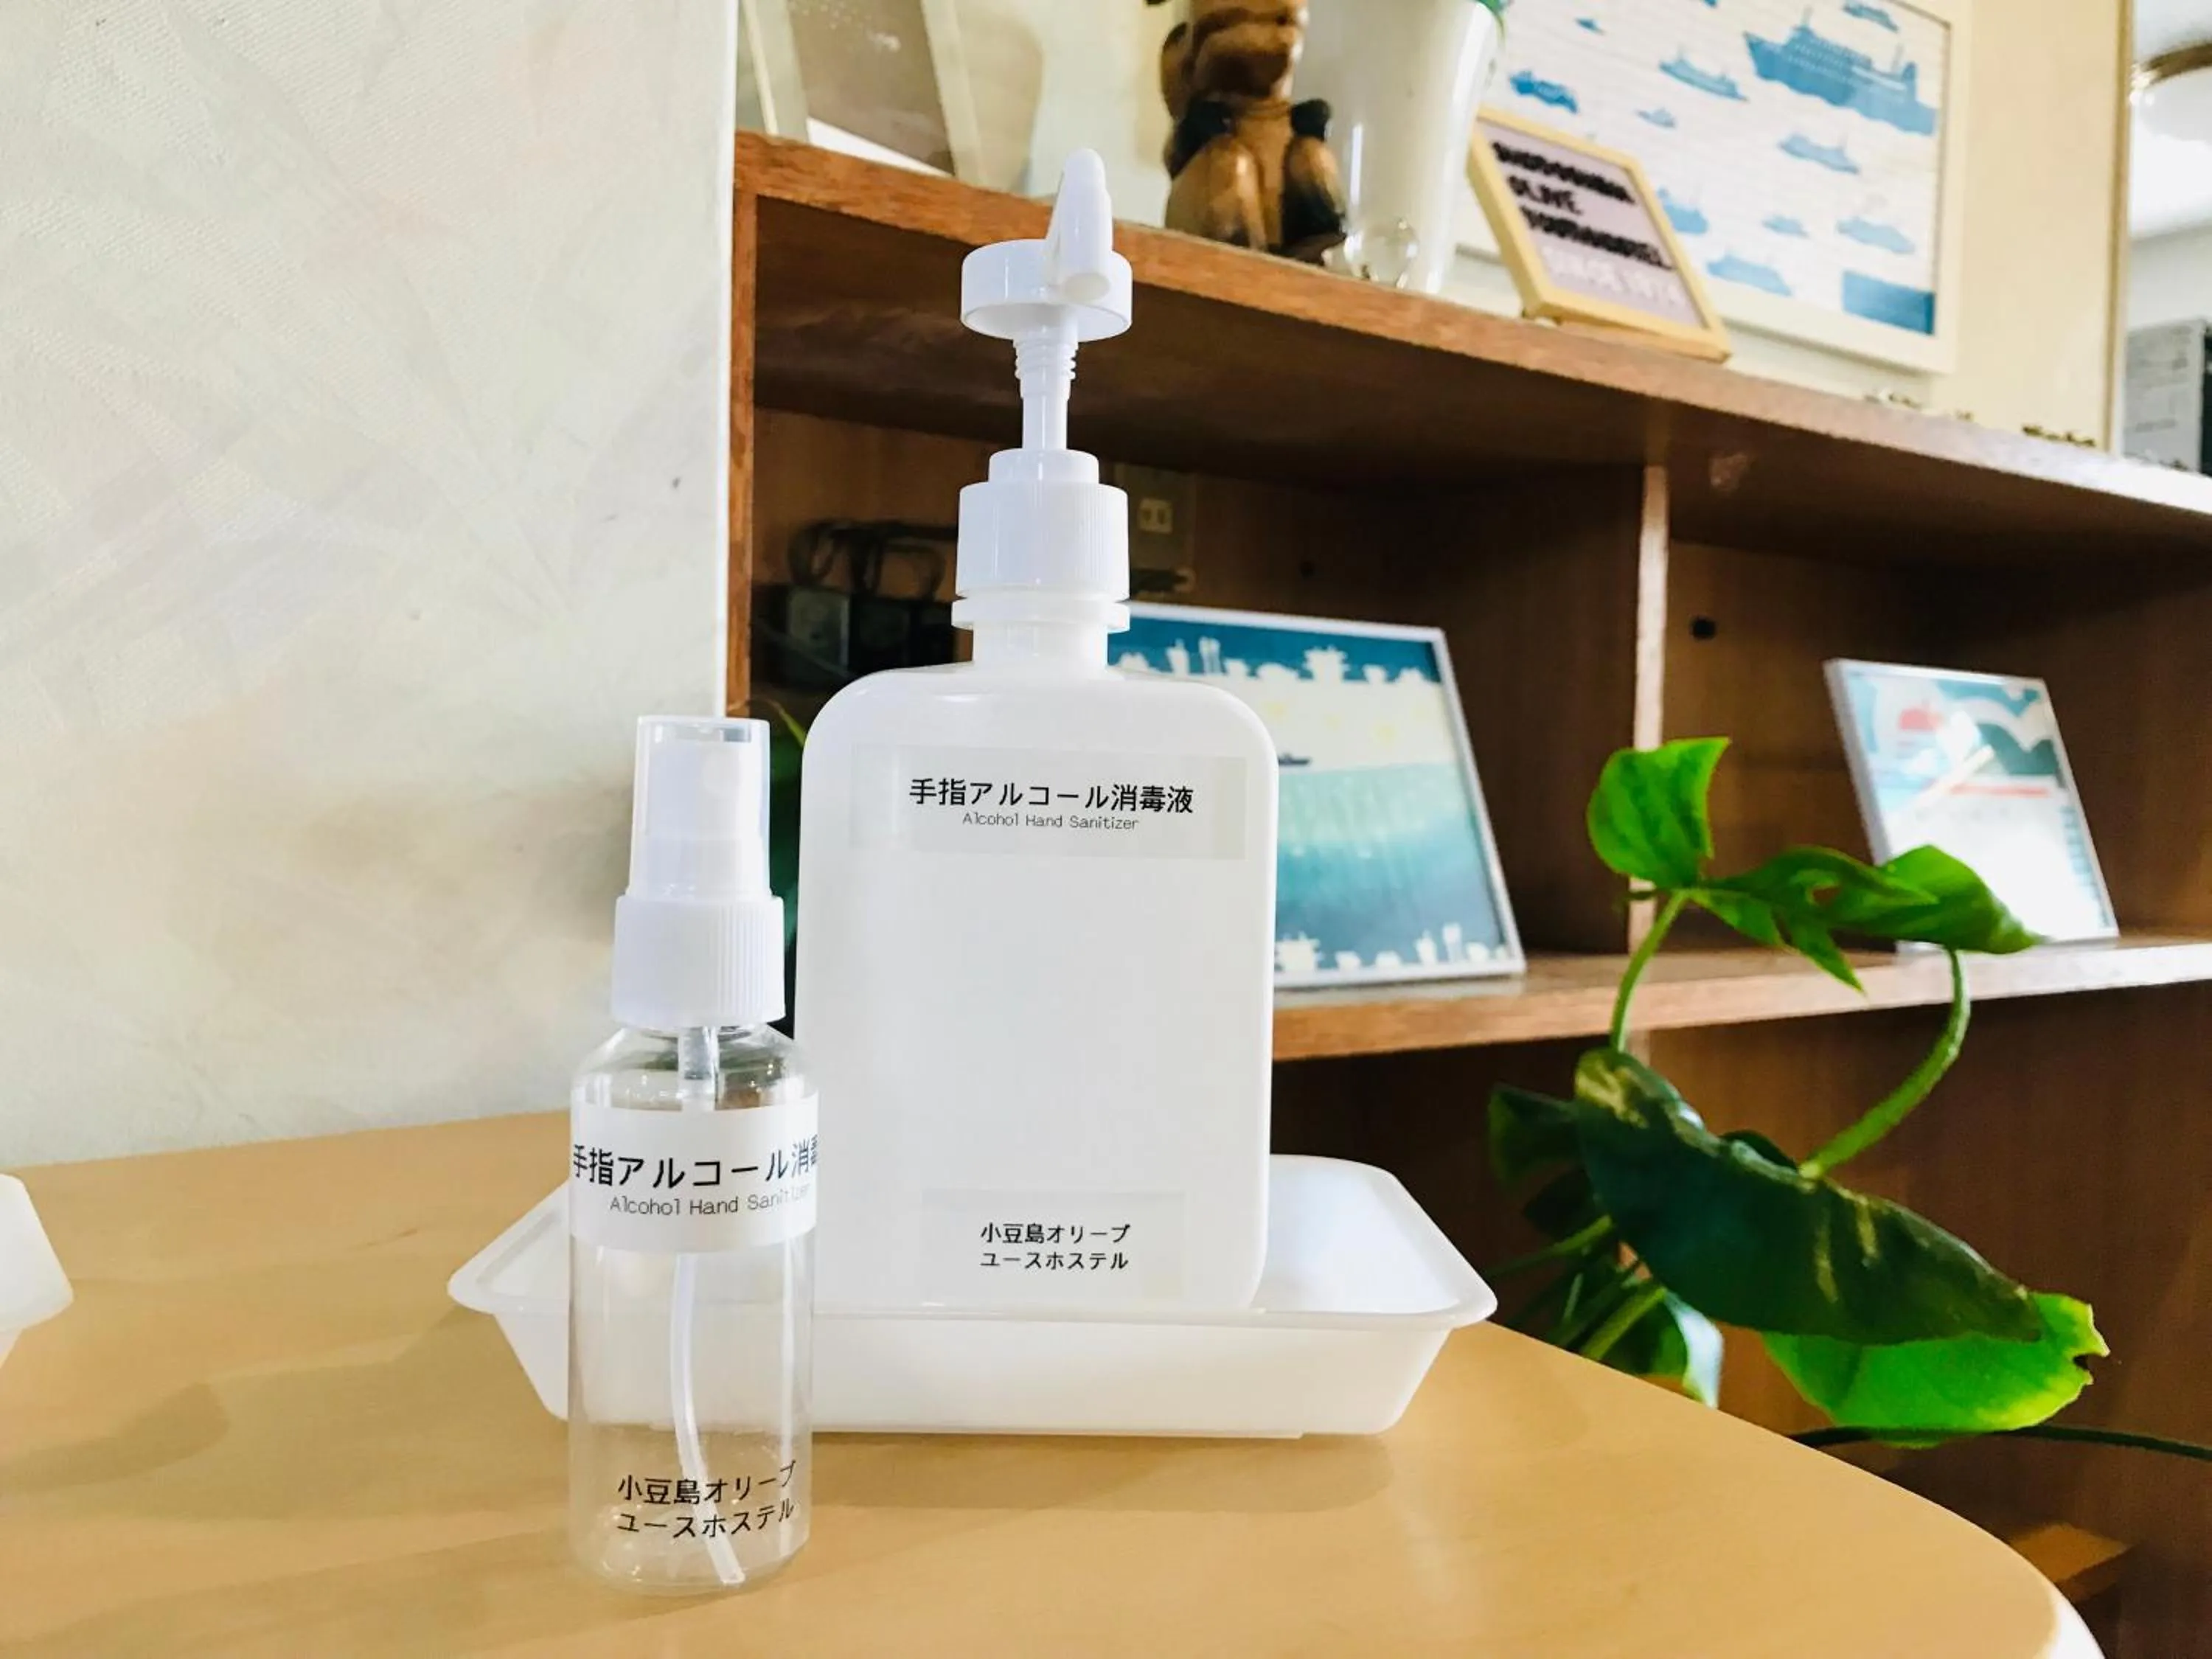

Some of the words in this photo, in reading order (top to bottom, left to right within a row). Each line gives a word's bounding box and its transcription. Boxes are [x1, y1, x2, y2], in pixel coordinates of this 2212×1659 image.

[908, 777, 1194, 813] 手指アルコール消毒液
[962, 812, 1019, 827] Alcohol
[1026, 814, 1063, 828] Hand
[1069, 815, 1139, 830] Sanitizer
[610, 1194, 681, 1216] Alcohol
[689, 1196, 739, 1216] Hand
[980, 1252, 1129, 1270] ユースホステル
[616, 1498, 795, 1539] ユースホステル
